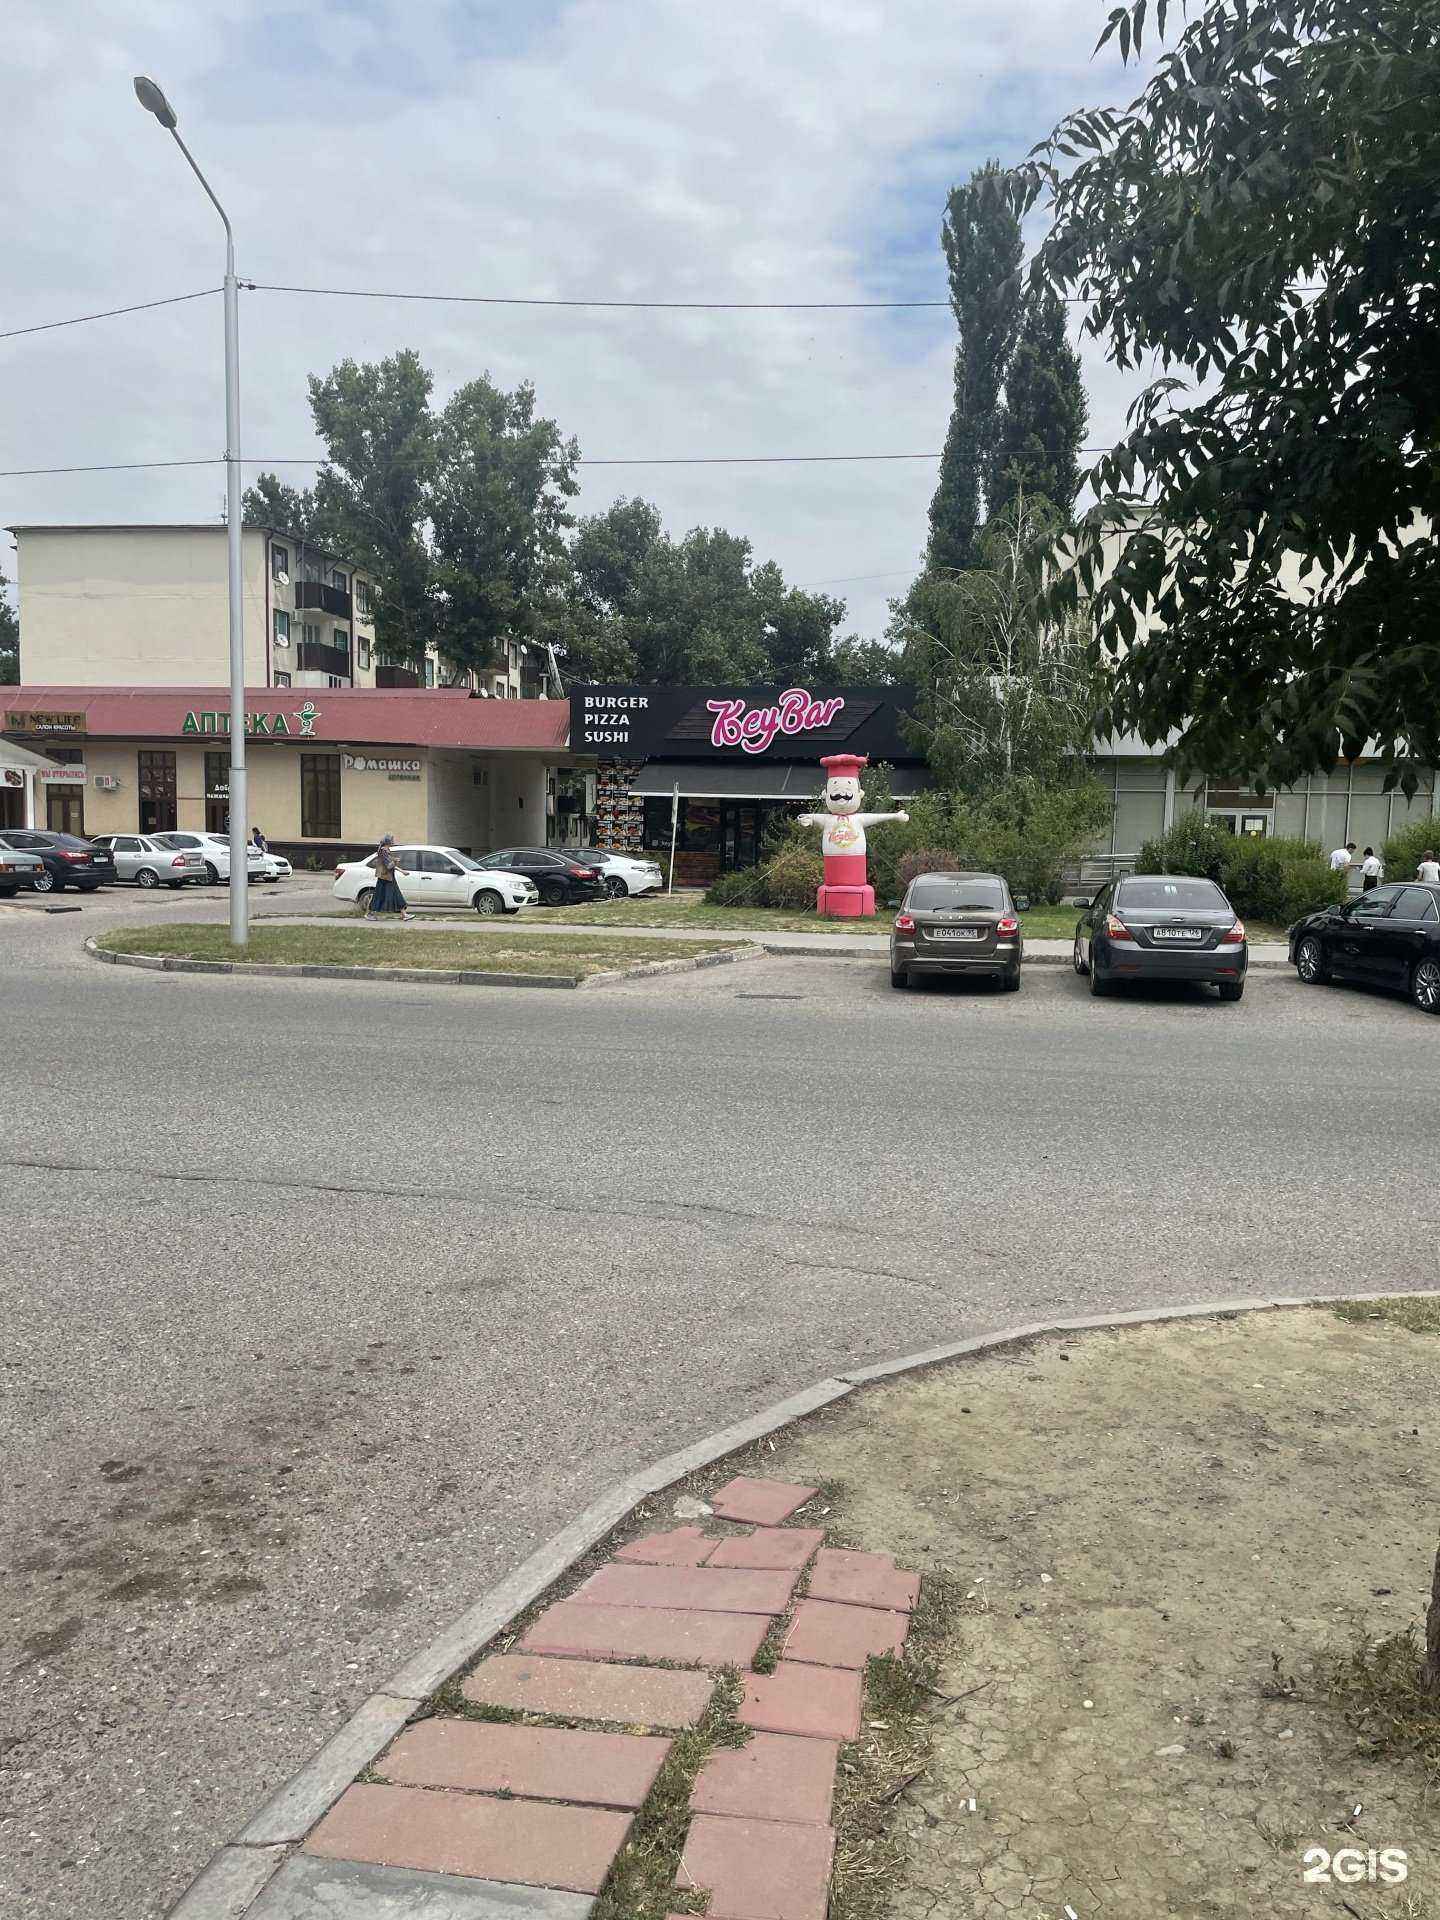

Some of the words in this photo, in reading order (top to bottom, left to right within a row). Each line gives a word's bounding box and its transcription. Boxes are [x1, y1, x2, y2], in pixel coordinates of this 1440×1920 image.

[584, 696, 649, 709] BURGER
[584, 713, 630, 725] PIZZA
[706, 688, 845, 754] KeyBar
[584, 731, 629, 743] SUSHI
